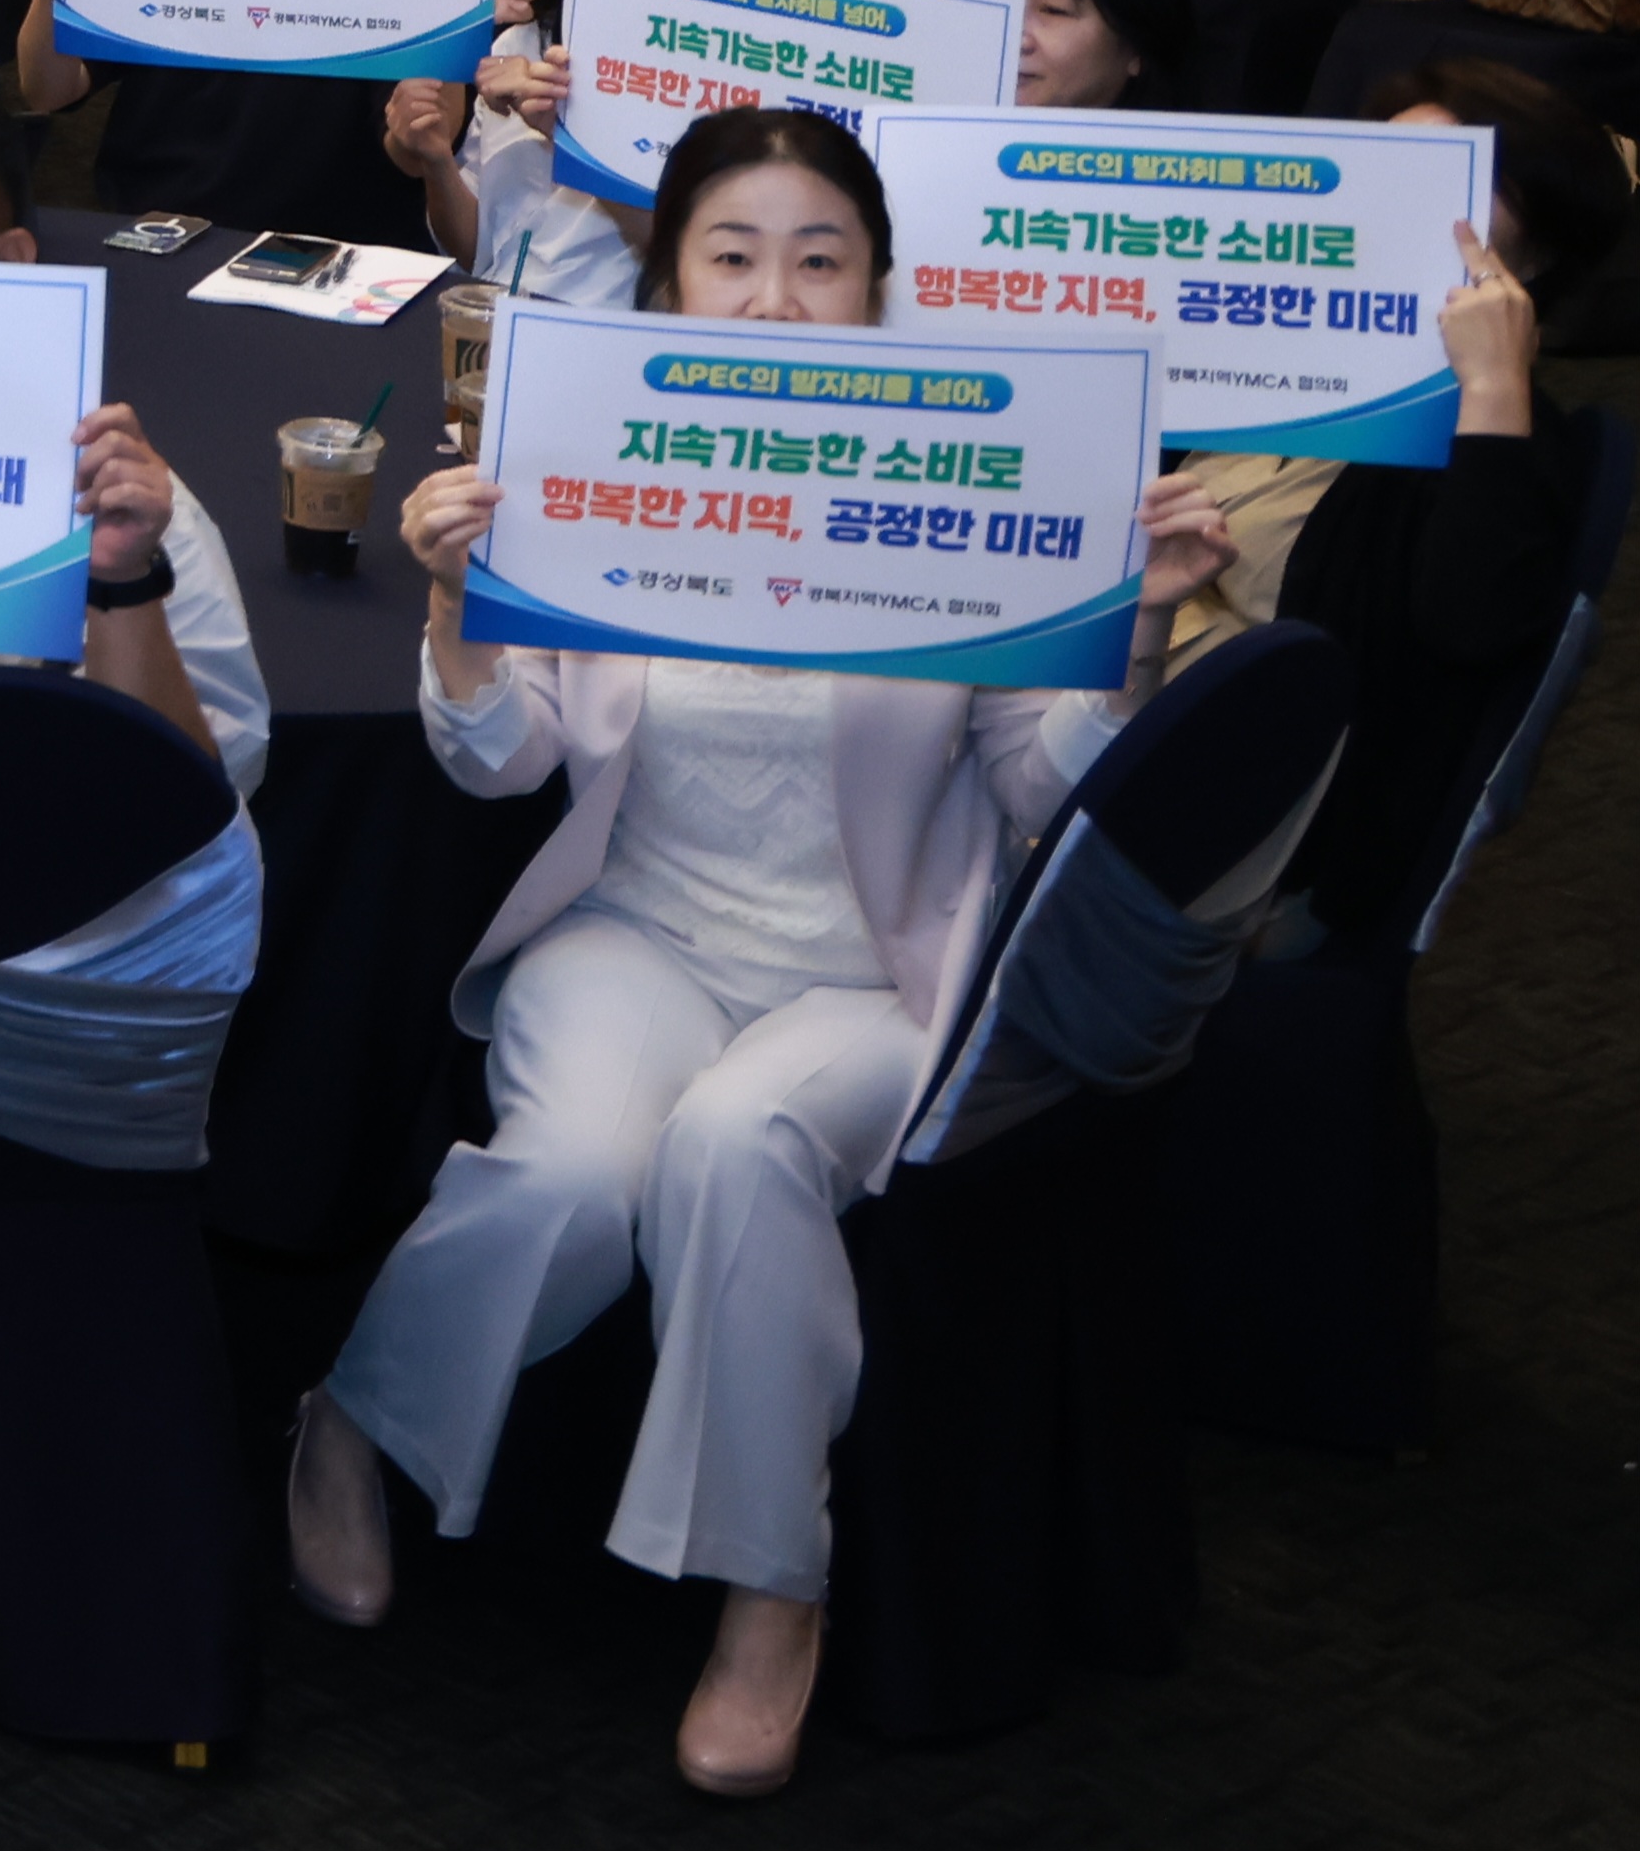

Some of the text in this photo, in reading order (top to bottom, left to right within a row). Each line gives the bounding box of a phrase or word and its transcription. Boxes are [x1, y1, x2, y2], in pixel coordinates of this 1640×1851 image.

[664, 362, 990, 406] APEC의 발자취를 넘어,
[619, 420, 1023, 491] 지속가능한 소비로
[542, 476, 1084, 559] 행복한 지역, 공정한 미래
